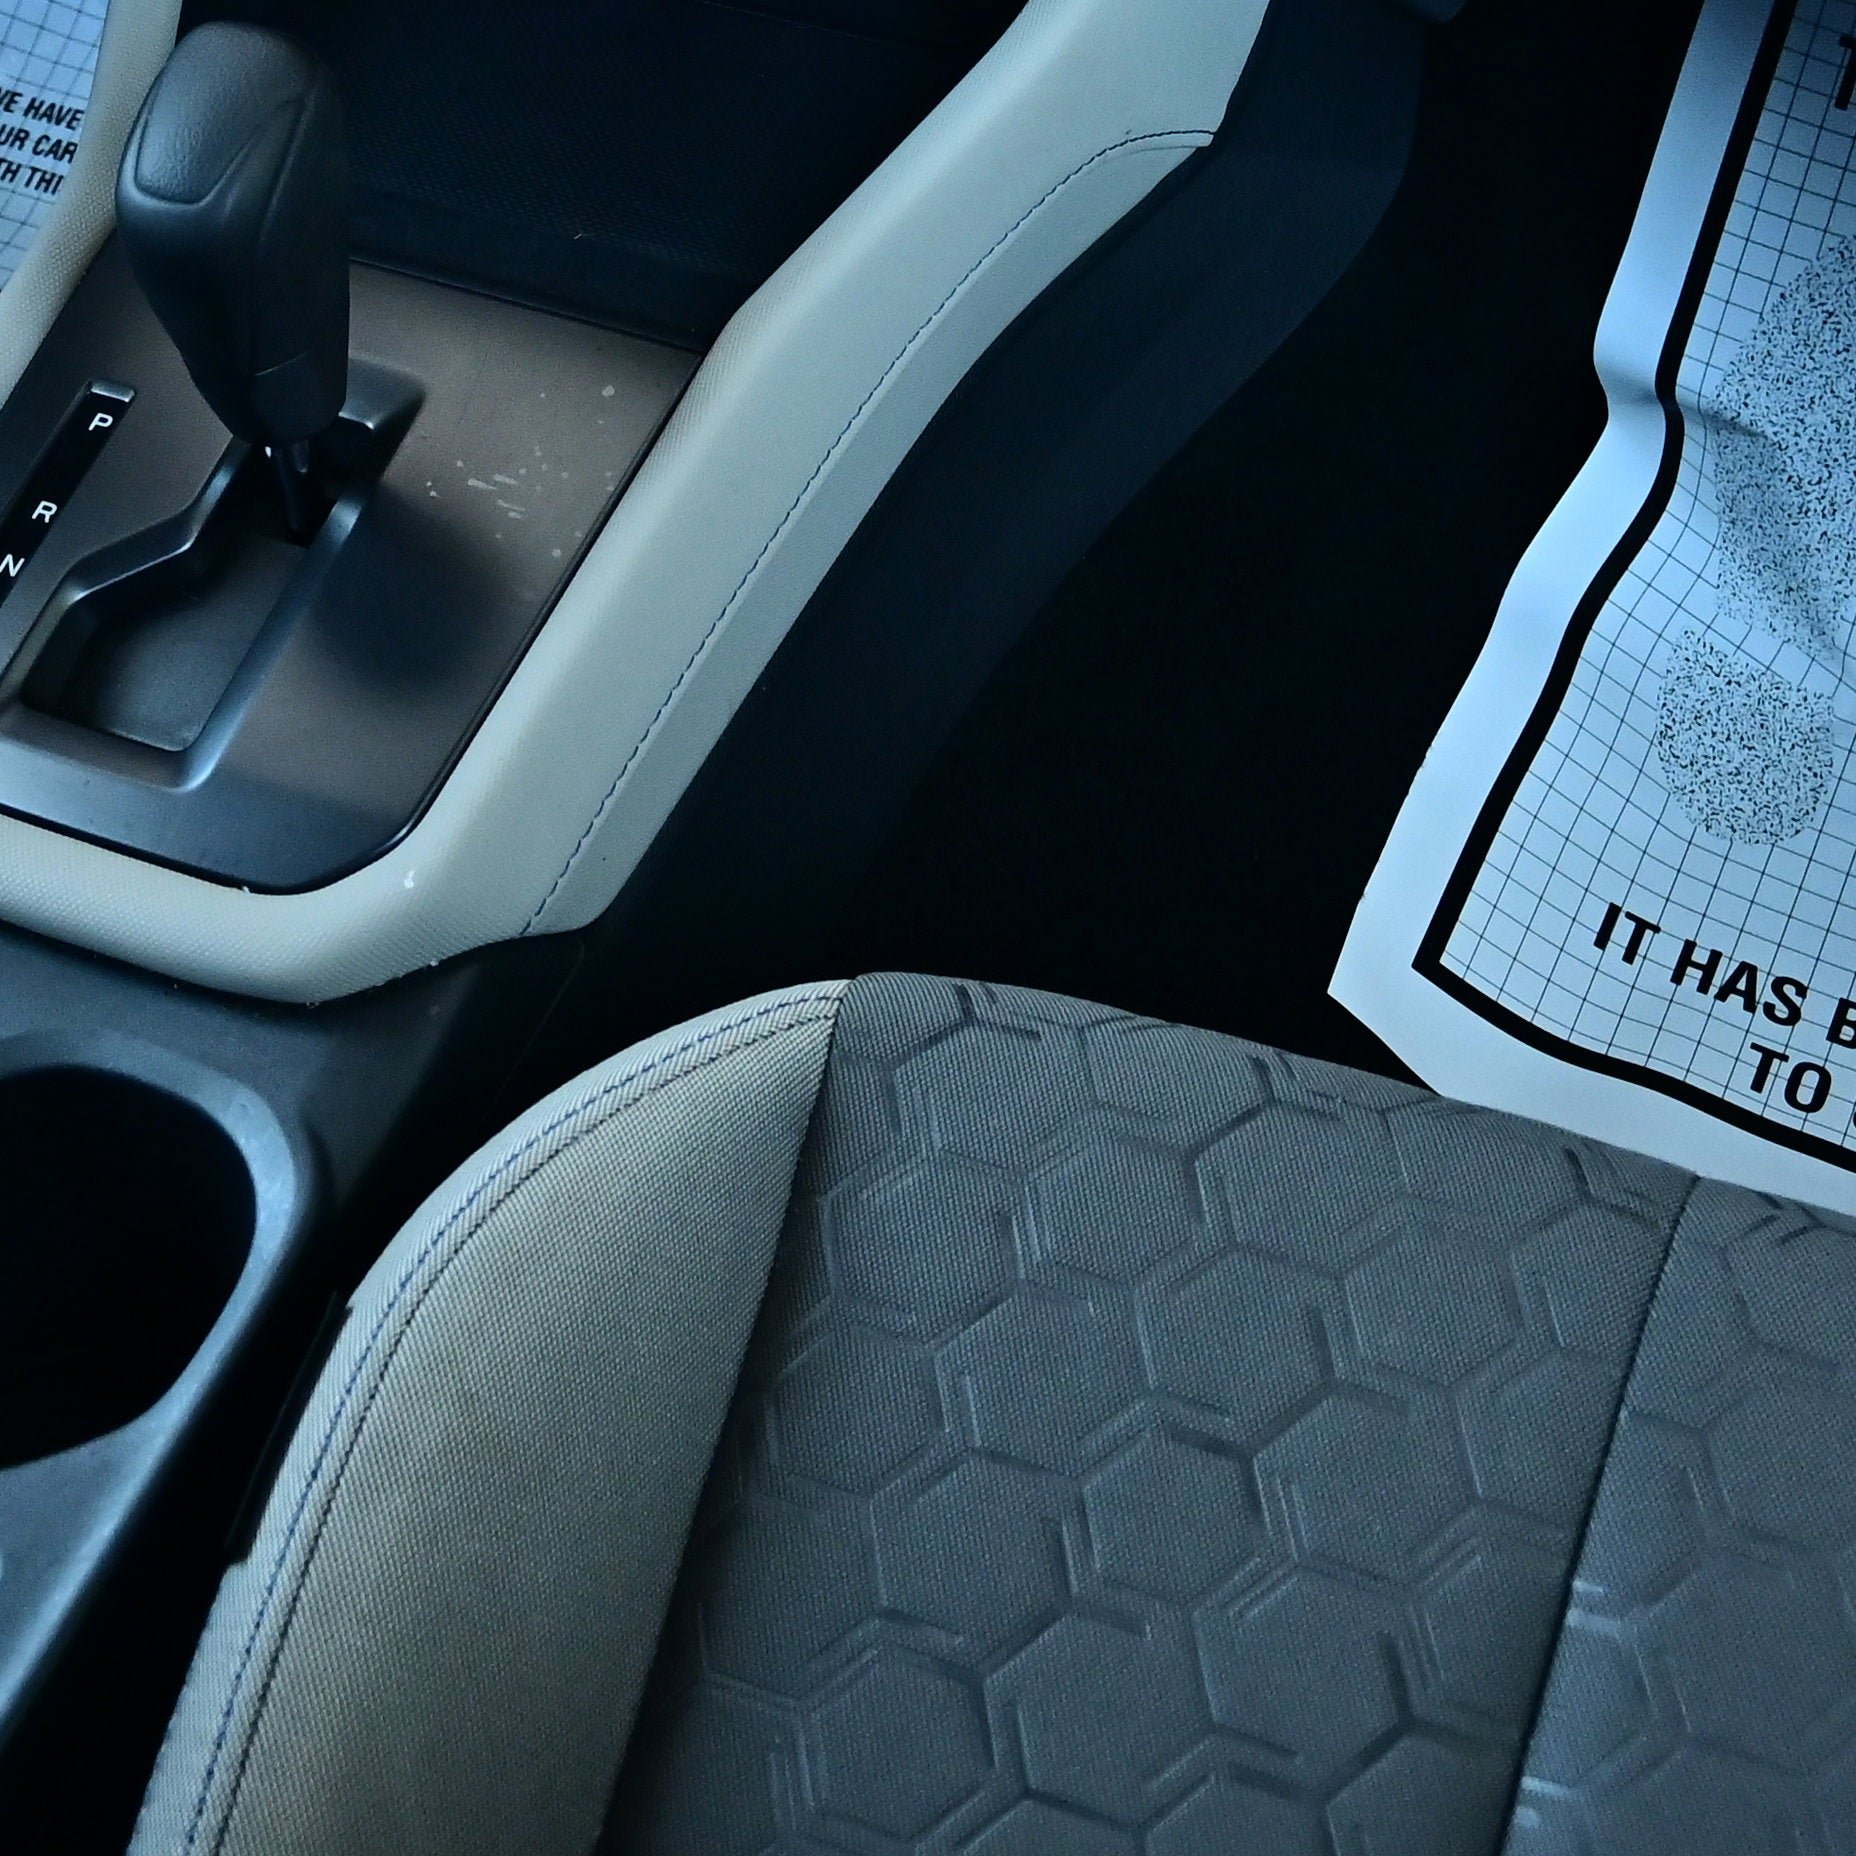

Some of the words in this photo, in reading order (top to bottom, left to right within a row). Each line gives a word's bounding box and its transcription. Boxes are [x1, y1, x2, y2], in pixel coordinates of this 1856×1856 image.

[23, 97, 85, 131] HAVE
[87, 412, 113, 431] P
[31, 501, 58, 523] R
[1593, 901, 1662, 966] IT
[1669, 938, 1810, 1027] HAS
[1748, 1041, 1833, 1114] TO
